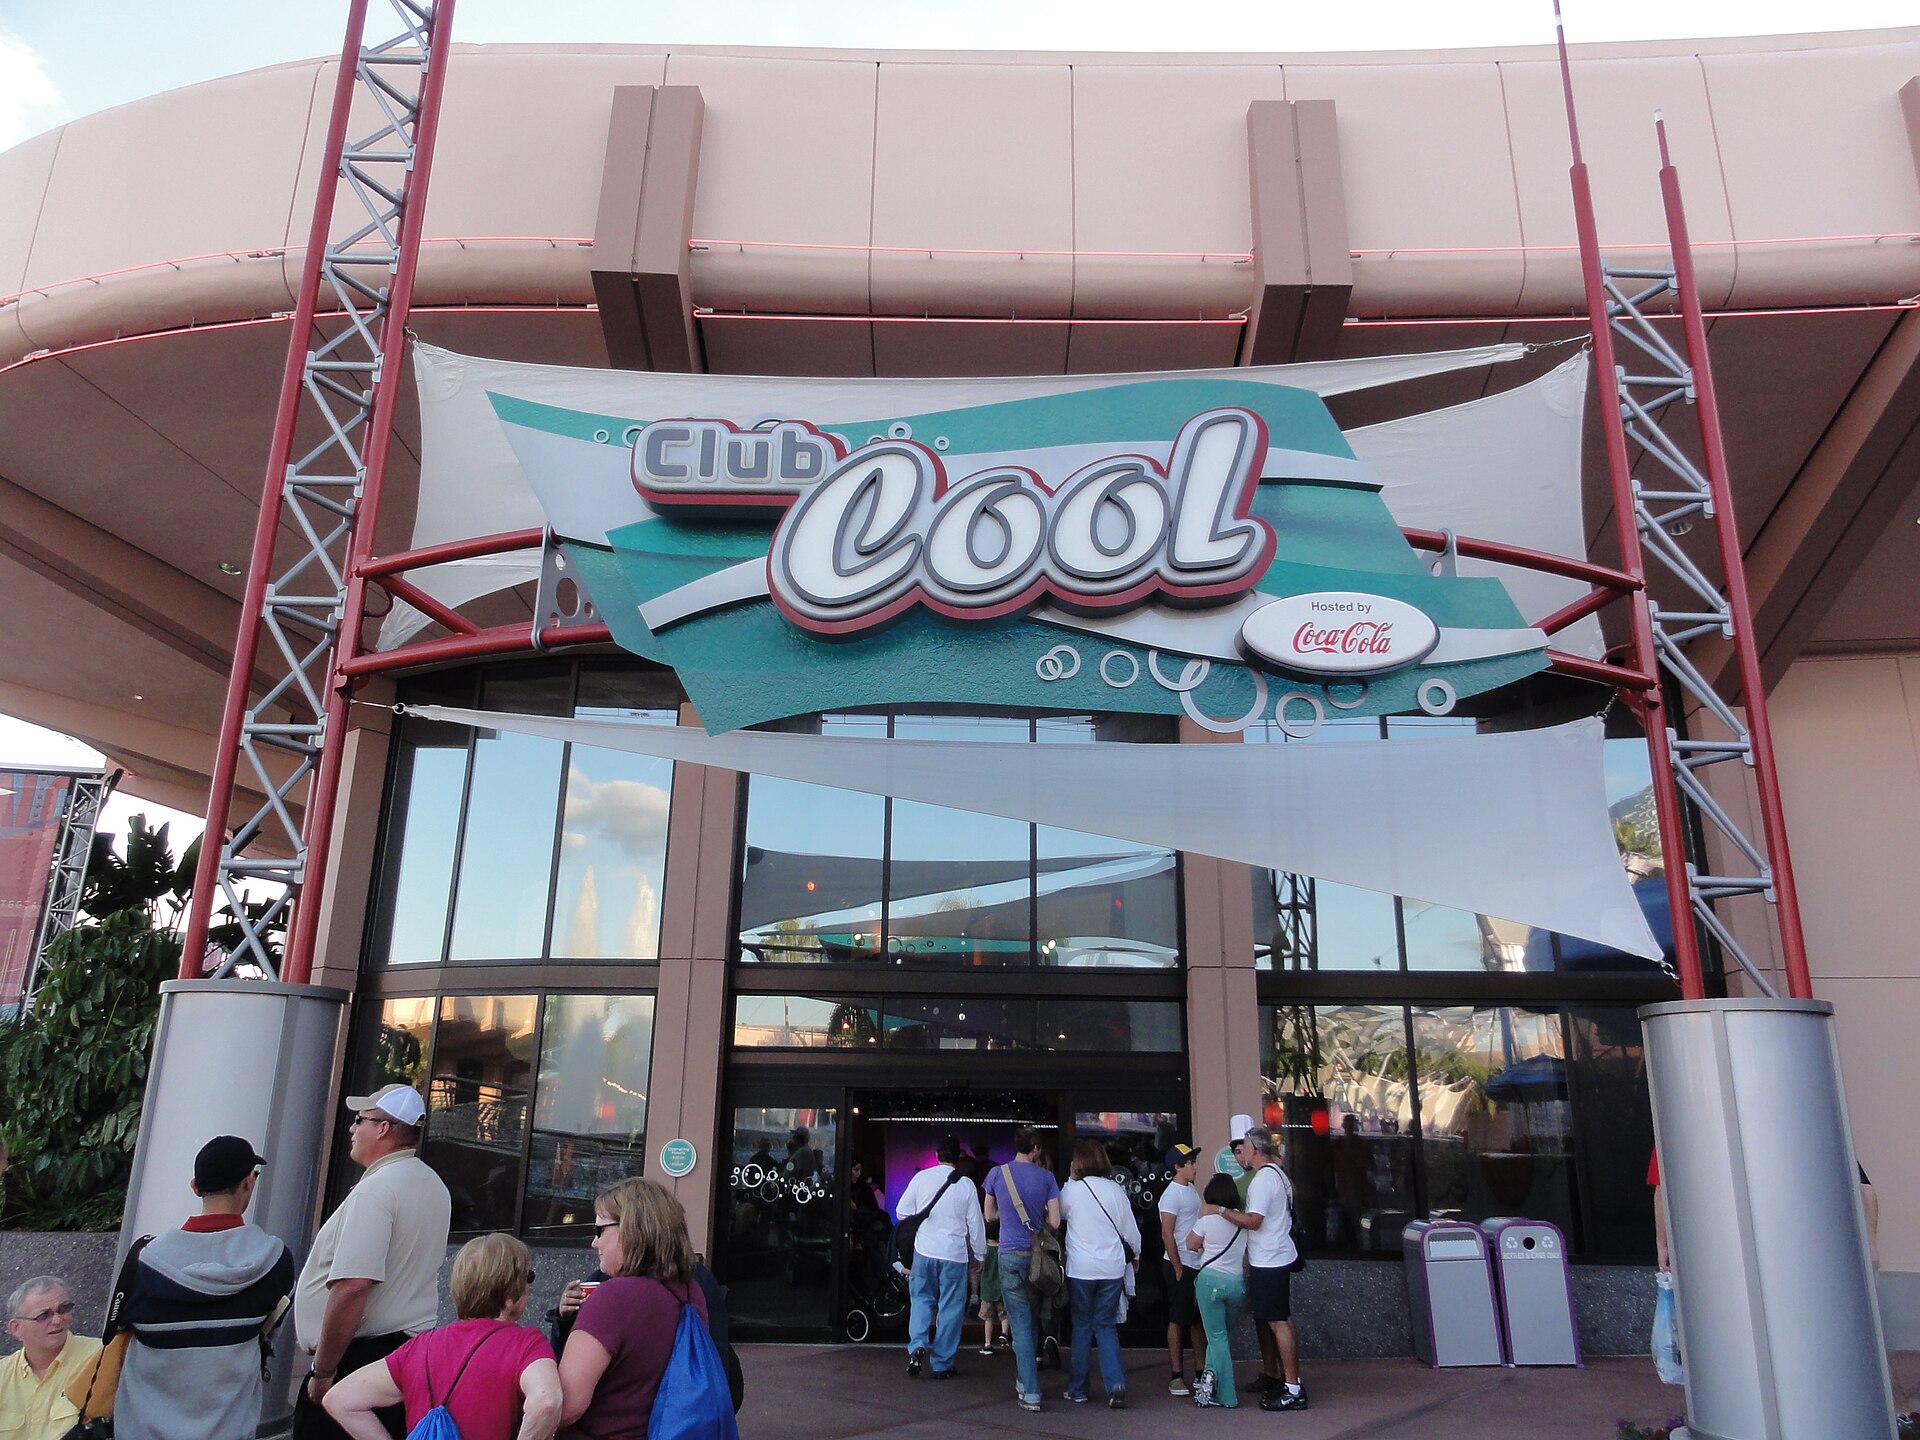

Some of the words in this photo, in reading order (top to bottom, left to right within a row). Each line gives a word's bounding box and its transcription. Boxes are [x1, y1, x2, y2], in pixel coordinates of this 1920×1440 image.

[643, 427, 827, 483] Club
[779, 413, 1267, 606] Cool
[1311, 601, 1354, 612] Hosted
[1357, 601, 1371, 614] by
[1292, 621, 1394, 654] Coca-Cola
[110, 1291, 125, 1321] Canon
